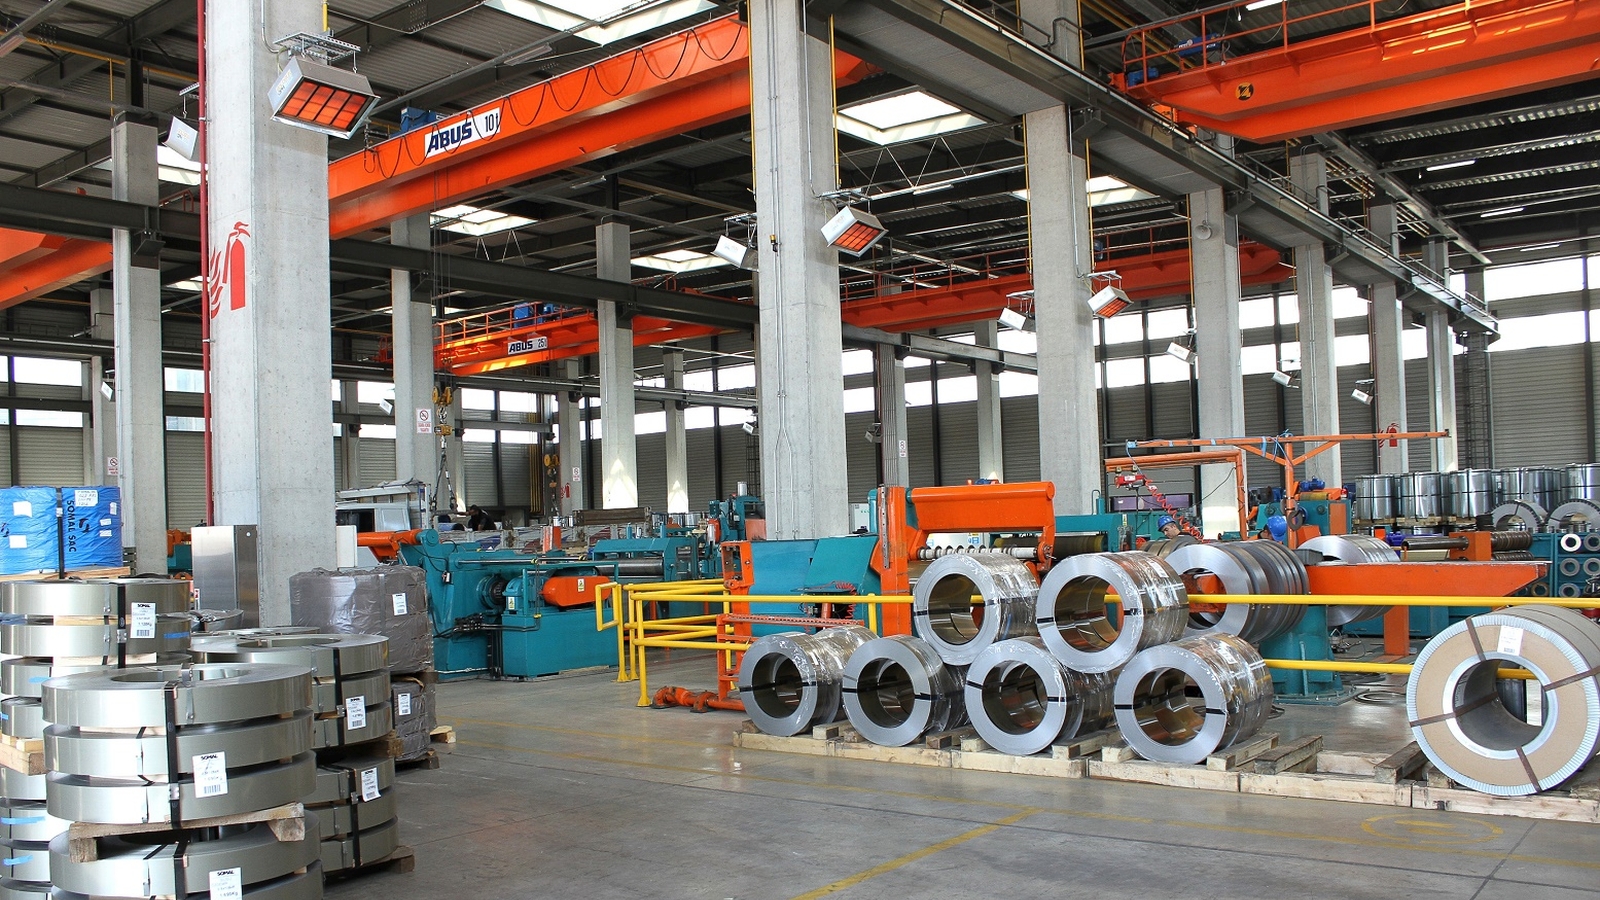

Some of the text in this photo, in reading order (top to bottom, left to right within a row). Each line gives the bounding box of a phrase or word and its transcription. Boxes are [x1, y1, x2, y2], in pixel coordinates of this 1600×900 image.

[426, 120, 472, 154] ABUS
[509, 341, 533, 352] ABUS
[66, 500, 76, 552] SOMAL SAC
